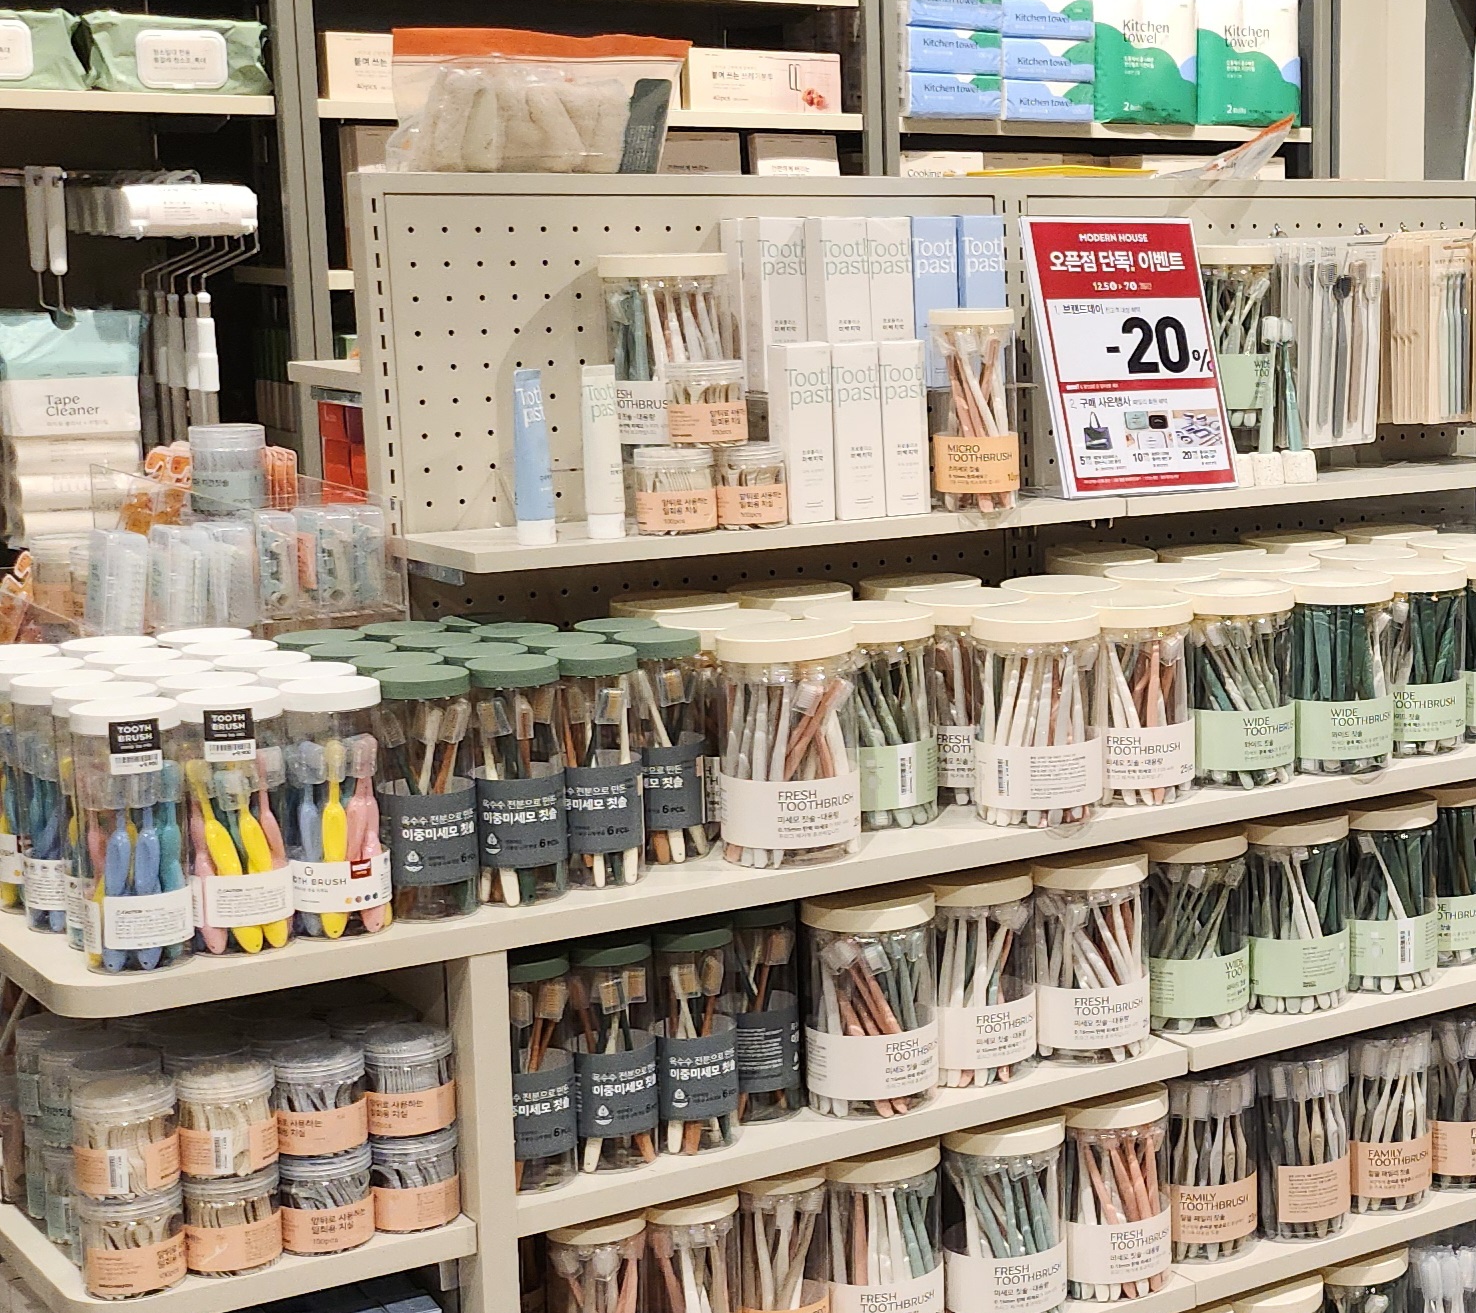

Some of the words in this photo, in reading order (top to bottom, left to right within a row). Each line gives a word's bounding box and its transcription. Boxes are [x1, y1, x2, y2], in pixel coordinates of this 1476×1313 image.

[1015, 14, 1046, 22] Kitchen
[1123, 20, 1169, 34] Kitchen
[1224, 25, 1269, 38] Kitchen
[924, 38, 954, 48] Kitchen
[1123, 32, 1157, 44] towel
[1225, 37, 1258, 48] towel
[1018, 57, 1048, 66] Kitchen
[1050, 58, 1071, 67] towel
[924, 84, 955, 93] Kitchen
[1019, 98, 1050, 107] Kitchen
[1052, 99, 1072, 107] towel
[1079, 233, 1116, 242] MODERN
[1118, 234, 1148, 242] HOUSE
[1050, 252, 1096, 272] 오픈점
[1098, 251, 1136, 272] 단독!
[1138, 252, 1185, 272] 이벤트
[1062, 304, 1104, 315] 브랜드데이
[45, 393, 80, 405] Tape
[1079, 398, 1096, 408] 구매
[1098, 396, 1131, 408] 사은행사
[45, 404, 100, 417] Cleaner
[948, 444, 980, 453] MICRO
[948, 451, 1012, 462] TOOTHBRUSH
[211, 714, 245, 723] TOOTH
[1331, 708, 1358, 717] WIDE
[1243, 717, 1270, 727] WIDE
[1331, 712, 1391, 727] TOOTHBRUSH
[118, 725, 152, 733] TOOTH
[118, 734, 152, 742] BRUSH
[1107, 736, 1141, 746] FRESH
[1107, 742, 1181, 755] TOOTHBRUSH
[662, 777, 683, 789] 칫솔
[778, 790, 817, 801] FRESH
[483, 799, 505, 810] 옥수수
[508, 797, 541, 809] 전분으로
[607, 797, 628, 810] 칫솔
[778, 794, 853, 812] TOOTHBRUSH
[402, 815, 428, 826] 옥수수
[430, 811, 462, 824] 전분으로
[483, 809, 537, 824] 이중미세모
[539, 807, 557, 822] 칫솔
[402, 826, 458, 842] 이중미세모
[1074, 996, 1110, 1006] FRESH
[1074, 998, 1143, 1016] TOOTHBRUSH
[976, 1012, 1010, 1024] FRESH
[886, 1040, 919, 1052] FRESH
[670, 1065, 721, 1080] 이중미세모
[1368, 1148, 1403, 1158] FAMILY
[1368, 1150, 1429, 1166] TOOTHBRUSH
[1180, 1192, 1217, 1202] FAMILY
[1180, 1195, 1249, 1211] TOOTHBRUSH
[1110, 1229, 1144, 1242] FRESH
[994, 1264, 1030, 1276] FRESH
[994, 1262, 1062, 1286] TOOTHBRUSH
[860, 1292, 897, 1304] FRESH
[860, 1290, 935, 1313] TOOTHBRUSH
